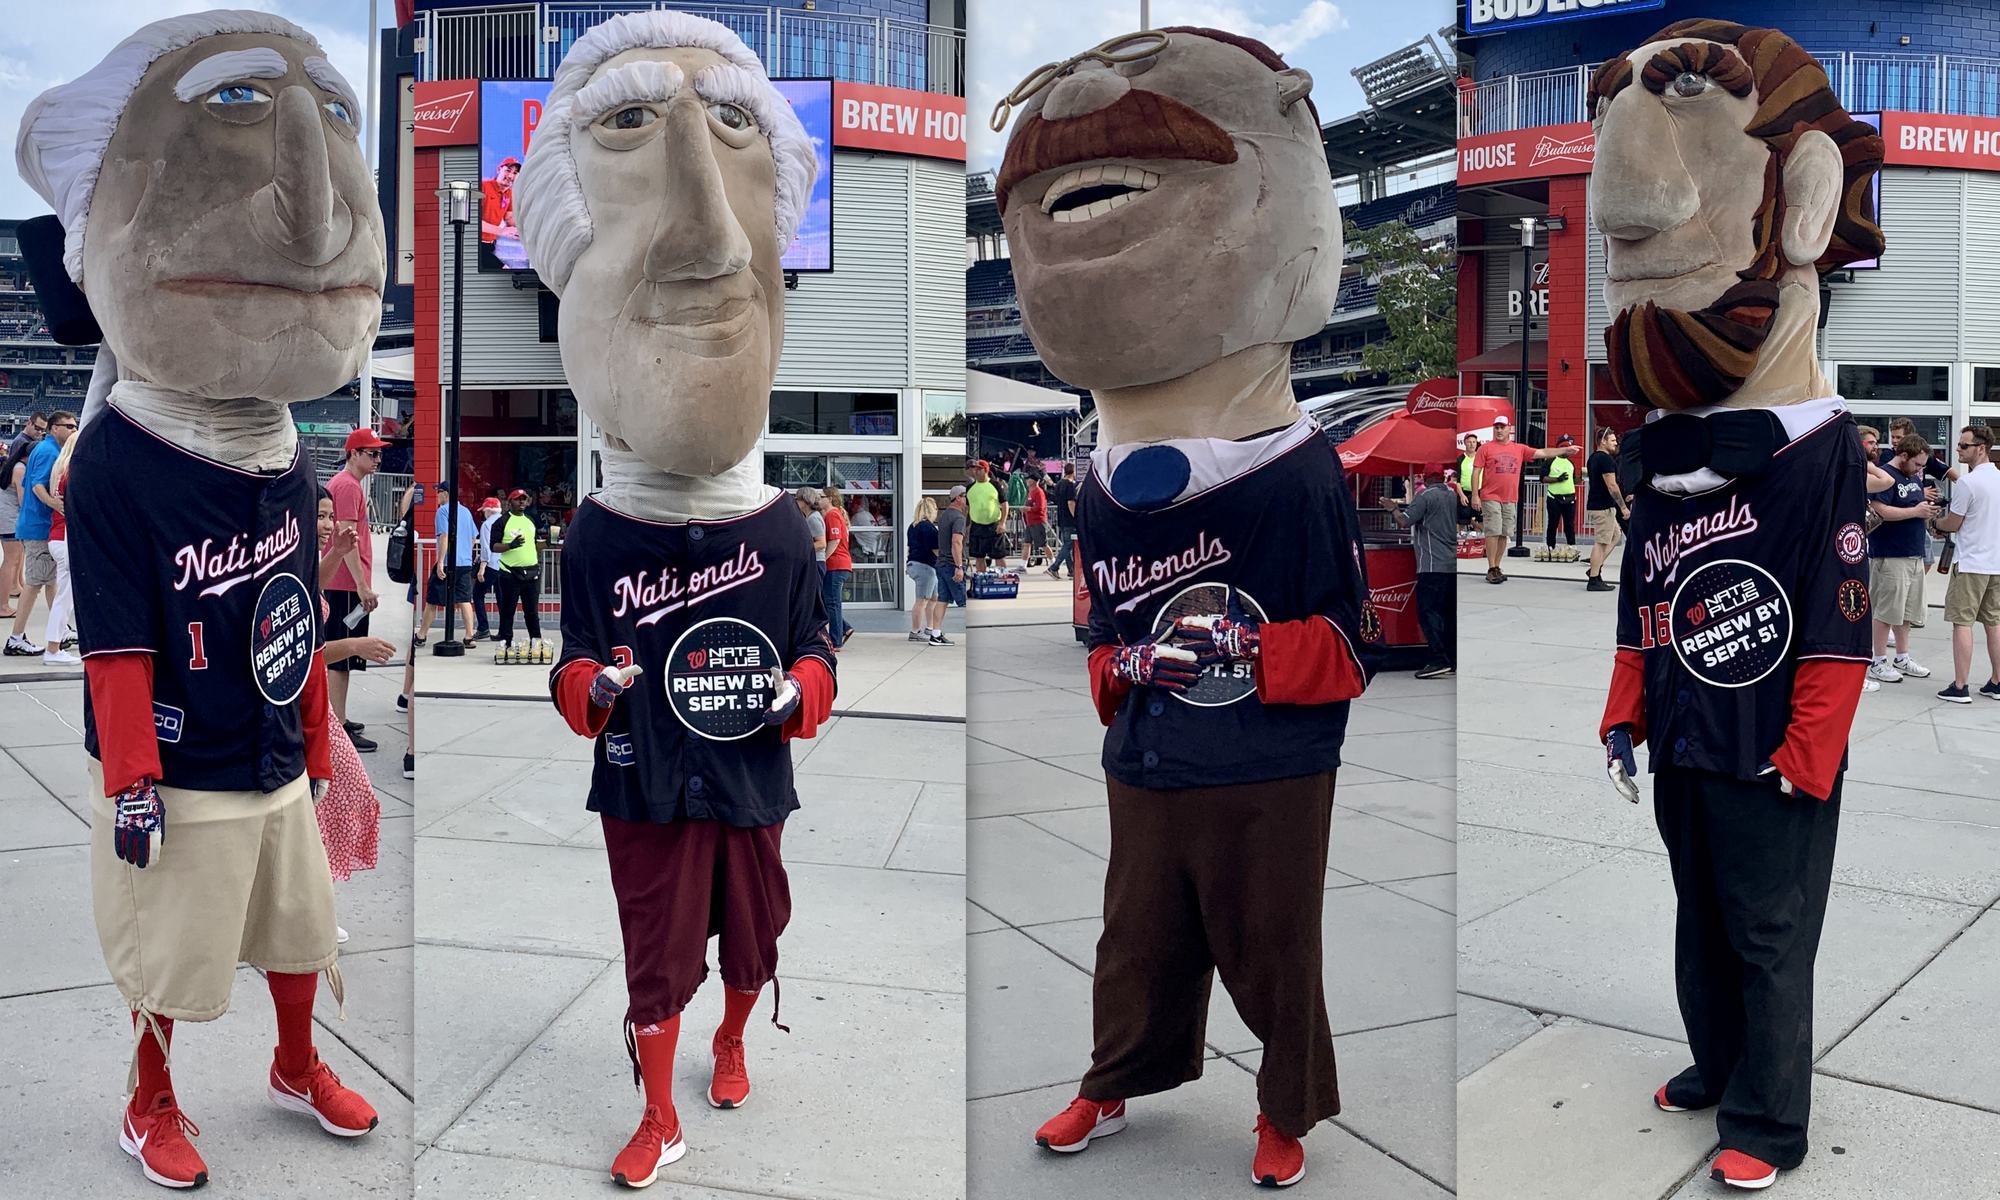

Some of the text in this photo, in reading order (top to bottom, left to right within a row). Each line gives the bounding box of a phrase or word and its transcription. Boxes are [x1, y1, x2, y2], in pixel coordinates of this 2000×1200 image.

[842, 99, 919, 136] BREW
[1900, 125, 1969, 154] BREW
[1463, 143, 1516, 172] HOUSE
[174, 509, 300, 597] Nationals
[1644, 494, 1758, 590] Nationals
[612, 542, 765, 627] Nationals
[1093, 530, 1231, 612] Nationals
[271, 592, 299, 621] NATS
[1704, 577, 1757, 608] NATS
[1708, 587, 1760, 619] PLUS
[272, 604, 300, 632] PLUS
[1638, 600, 1674, 649] 16
[1681, 598, 1781, 656] RENEW BY
[188, 621, 208, 671] 1
[256, 614, 310, 671] RENEW BY
[709, 645, 760, 657] NATS
[1703, 623, 1779, 668] SEPT. 5!
[266, 639, 307, 684] SEPT. 5!
[710, 657, 760, 668] PLUS
[1232, 664, 1252, 679] 5!
[673, 674, 774, 693] RENEW BY
[688, 693, 764, 712] SEPT. 5!
